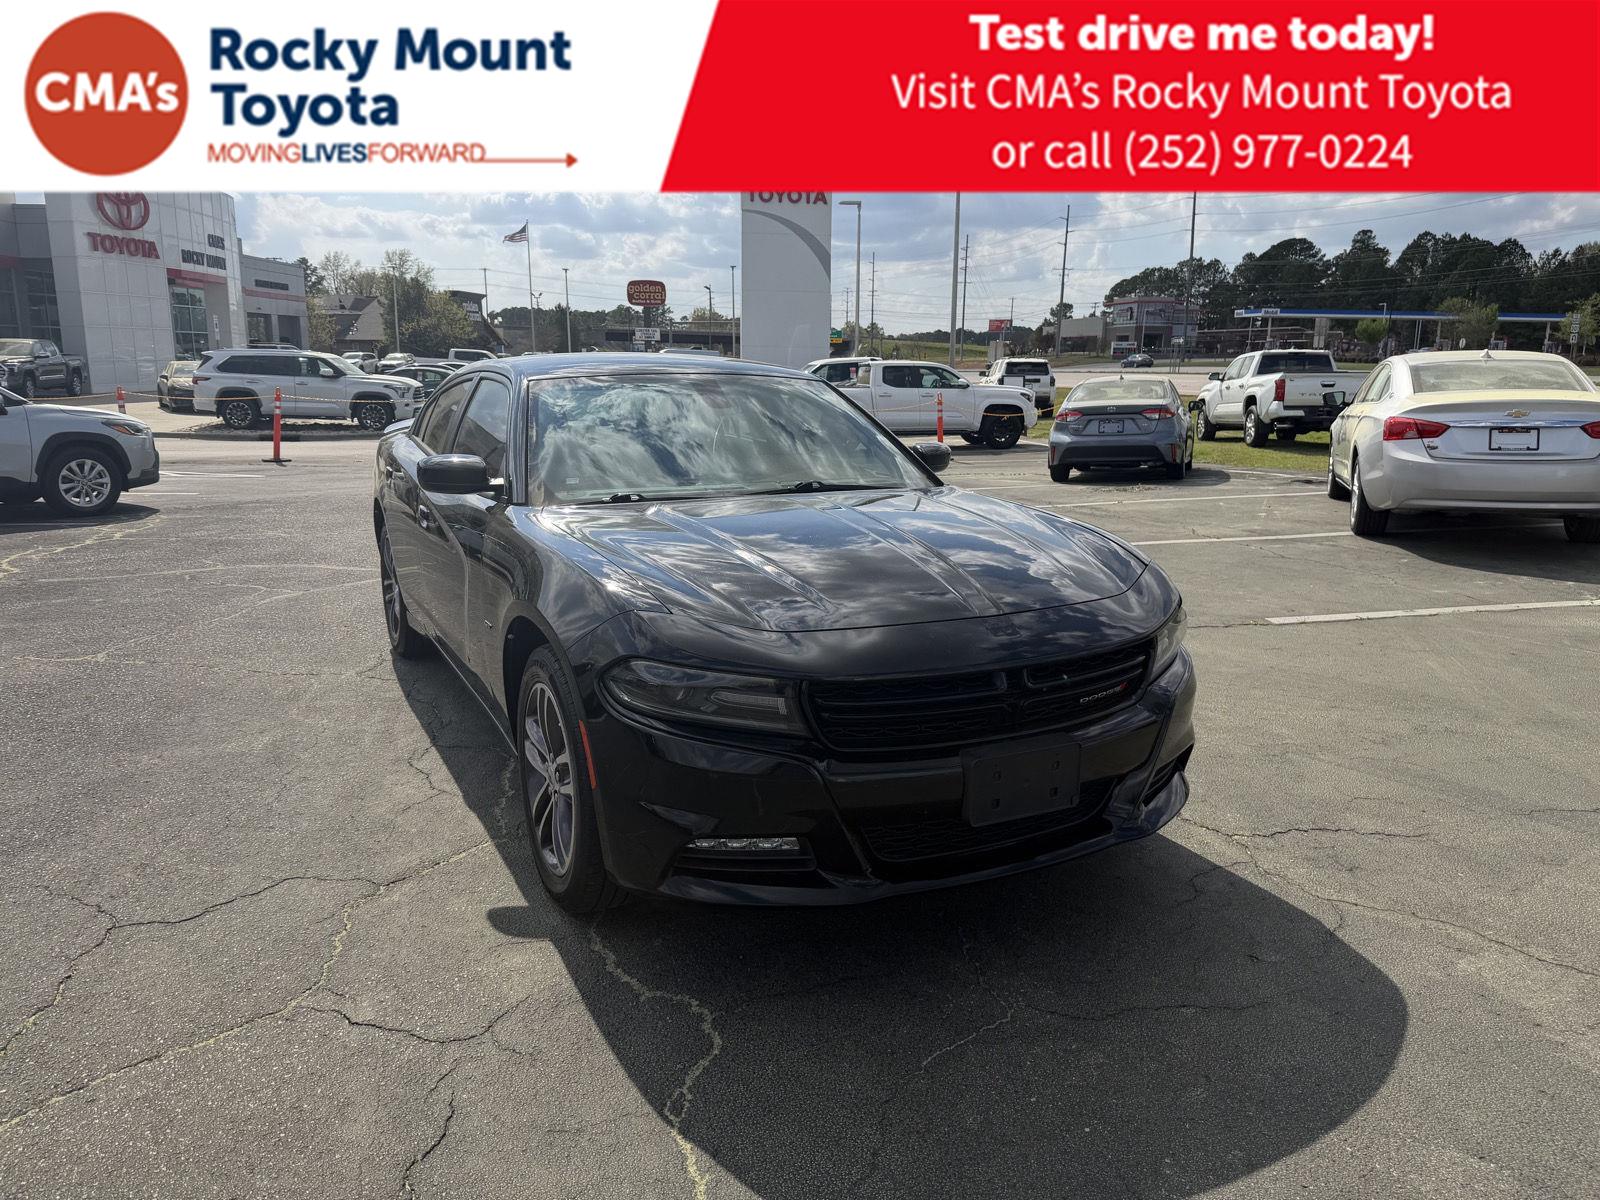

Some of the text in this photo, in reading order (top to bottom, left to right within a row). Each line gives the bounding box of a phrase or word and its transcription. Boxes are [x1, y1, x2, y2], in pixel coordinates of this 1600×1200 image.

[87, 231, 160, 259] TOYOTA
[628, 284, 662, 294] golden
[1080, 687, 1121, 702] DODGE
